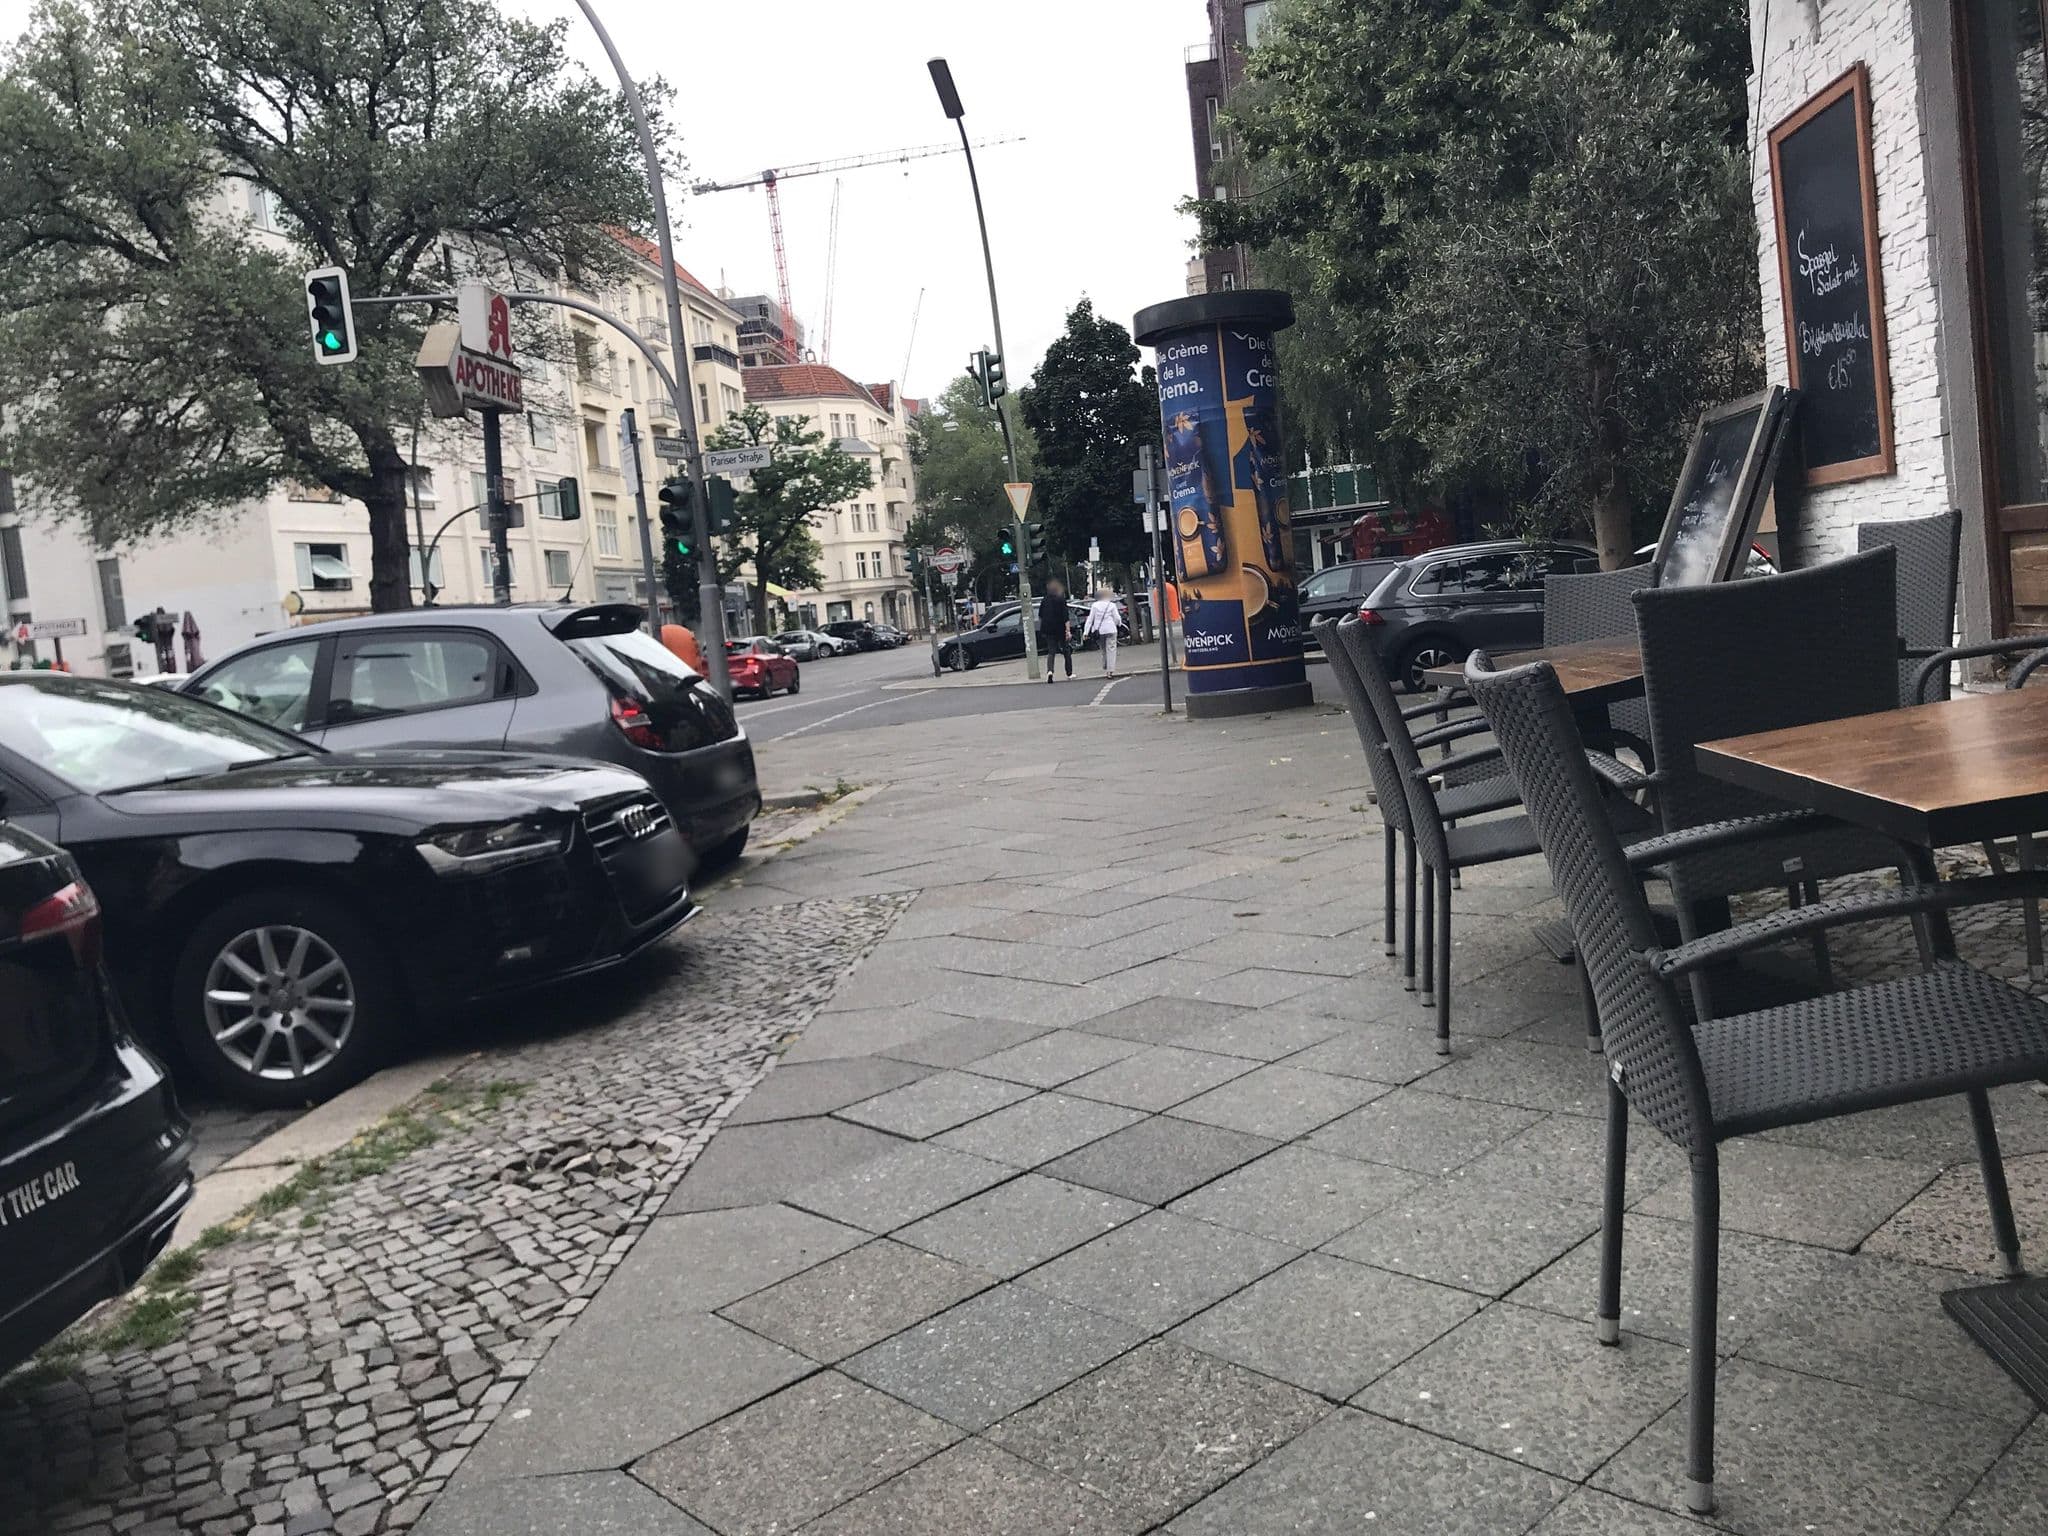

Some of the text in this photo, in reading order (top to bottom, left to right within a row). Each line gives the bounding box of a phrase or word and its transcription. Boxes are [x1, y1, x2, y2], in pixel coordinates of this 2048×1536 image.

[1167, 344, 1209, 361] Crème
[1248, 337, 1266, 351] Die
[455, 354, 520, 404] APOTHEKE
[1163, 363, 1186, 381] de la
[710, 450, 764, 467] Pariser Straße
[1173, 486, 1197, 500] Crema
[7, 1178, 46, 1218] THE
[43, 1161, 80, 1200] CAR
